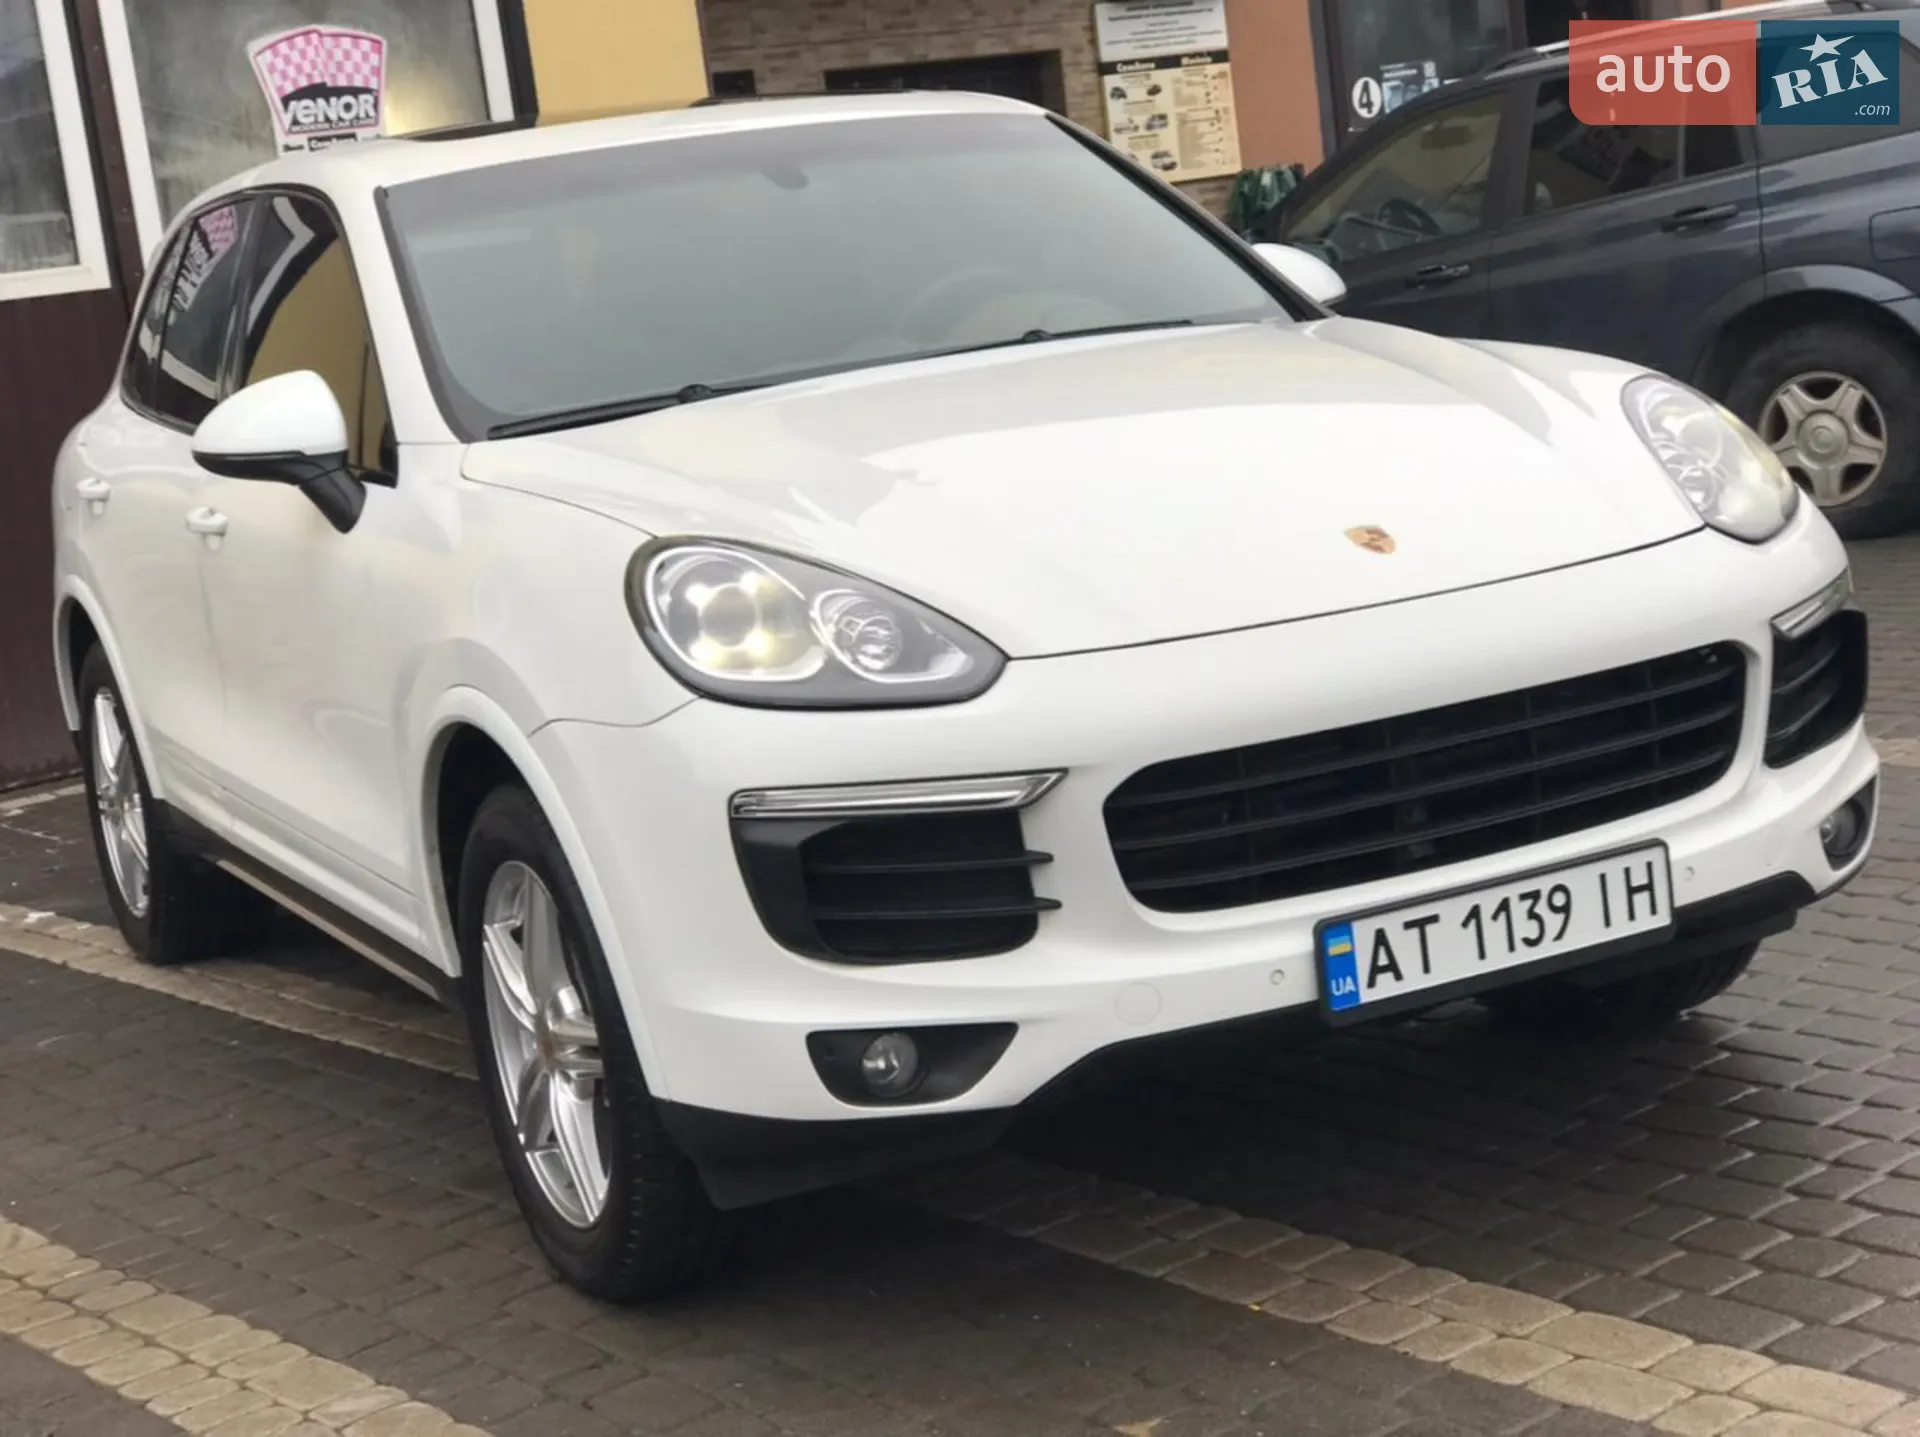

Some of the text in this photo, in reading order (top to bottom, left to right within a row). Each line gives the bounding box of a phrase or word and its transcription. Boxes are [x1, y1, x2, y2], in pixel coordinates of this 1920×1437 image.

[1358, 80, 1374, 114] 4
[1366, 861, 1658, 989] AT 1139 IH
[1331, 975, 1357, 997] UA
